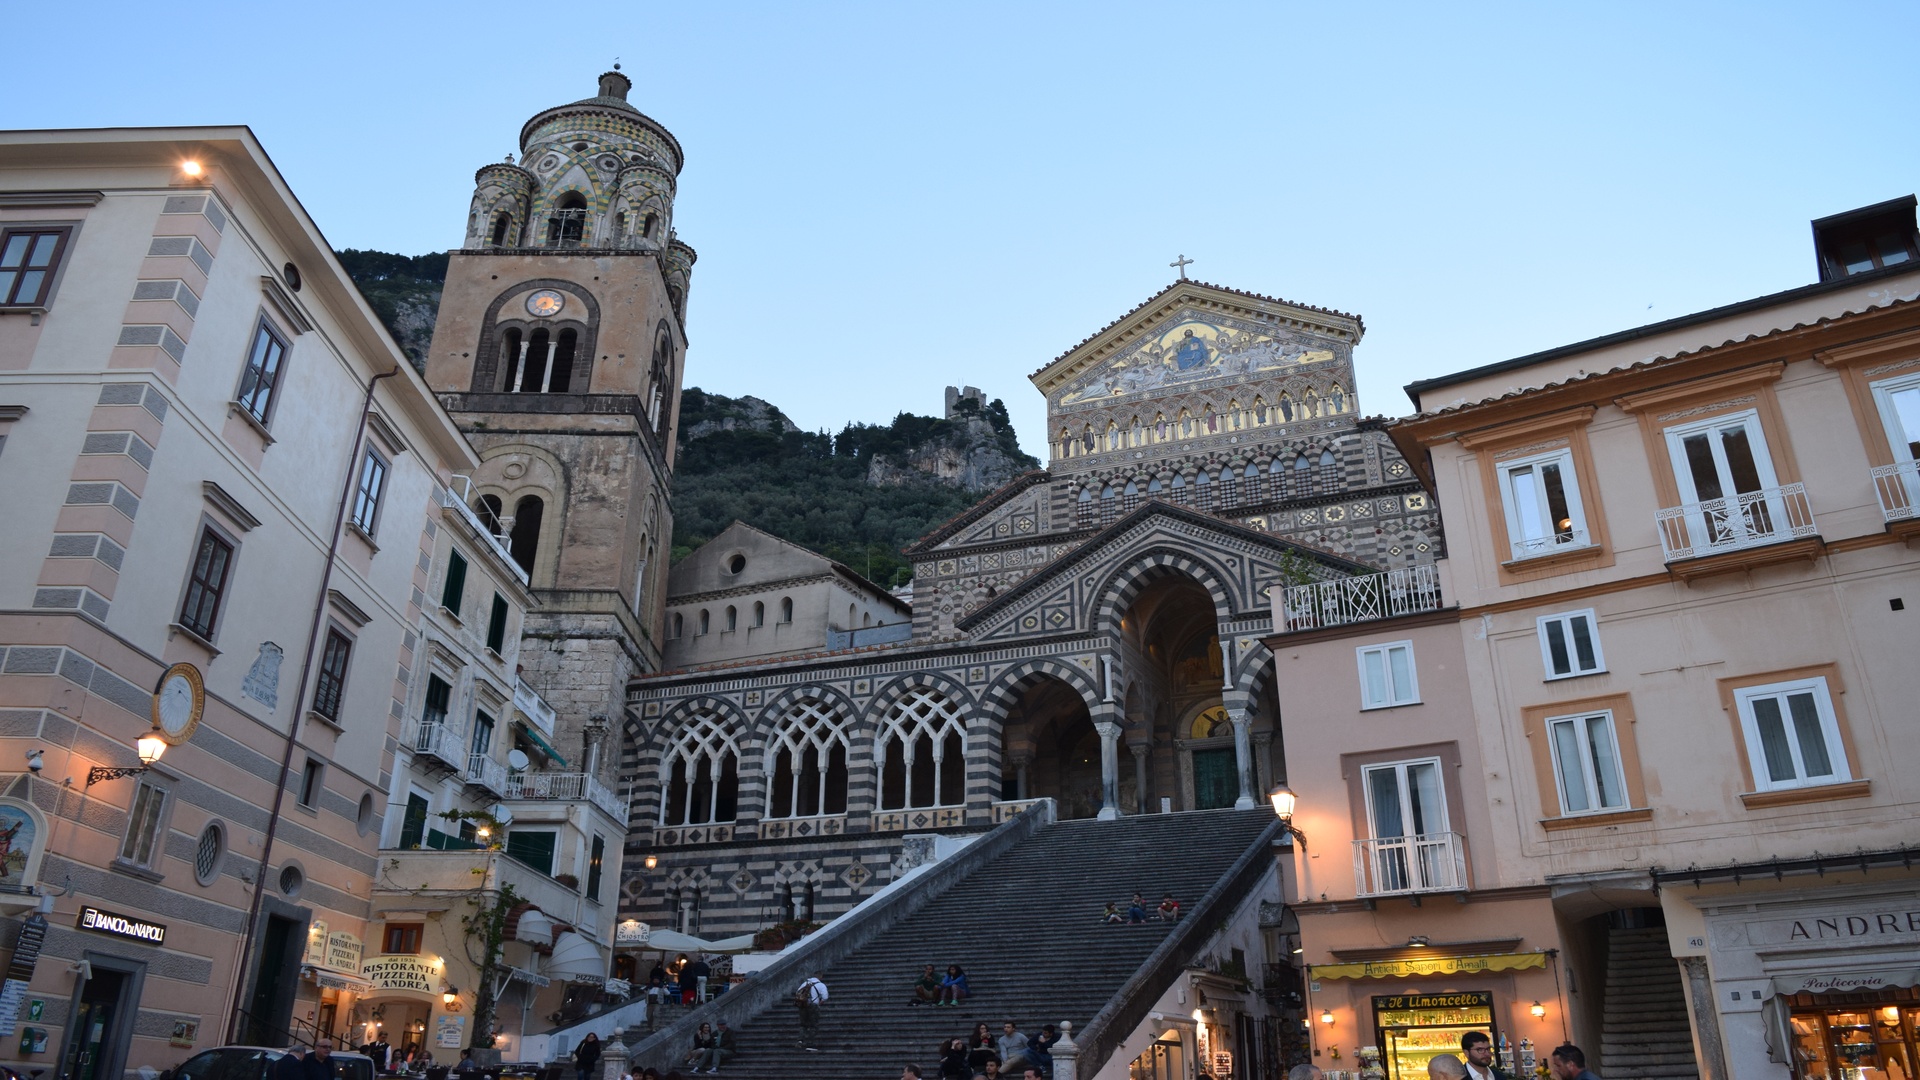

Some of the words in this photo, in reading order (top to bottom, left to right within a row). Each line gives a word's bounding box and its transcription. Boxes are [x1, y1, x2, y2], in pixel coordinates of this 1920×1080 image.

[95, 913, 127, 933] BANCO
[134, 922, 165, 942] NAPOLI
[1791, 911, 1920, 940] ANDRE
[330, 937, 361, 953] RISTORANTE
[1690, 938, 1703, 947] 40
[332, 948, 355, 960] PIZZERIA
[336, 959, 356, 971] ANDREA
[363, 963, 438, 976] RISTORANTE
[1365, 963, 1400, 975] Antichi
[1405, 961, 1441, 973] Sapori
[1446, 959, 1488, 970] d'Amalfi
[371, 972, 427, 982] PIZZERIA
[1802, 976, 1885, 988] Pasticceria
[320, 977, 347, 990] RISTORANTE
[347, 984, 365, 993] PIZZERIA
[381, 980, 430, 991] ANDREA
[1389, 997, 1403, 1008] Il
[1409, 994, 1479, 1007] Limoncello
